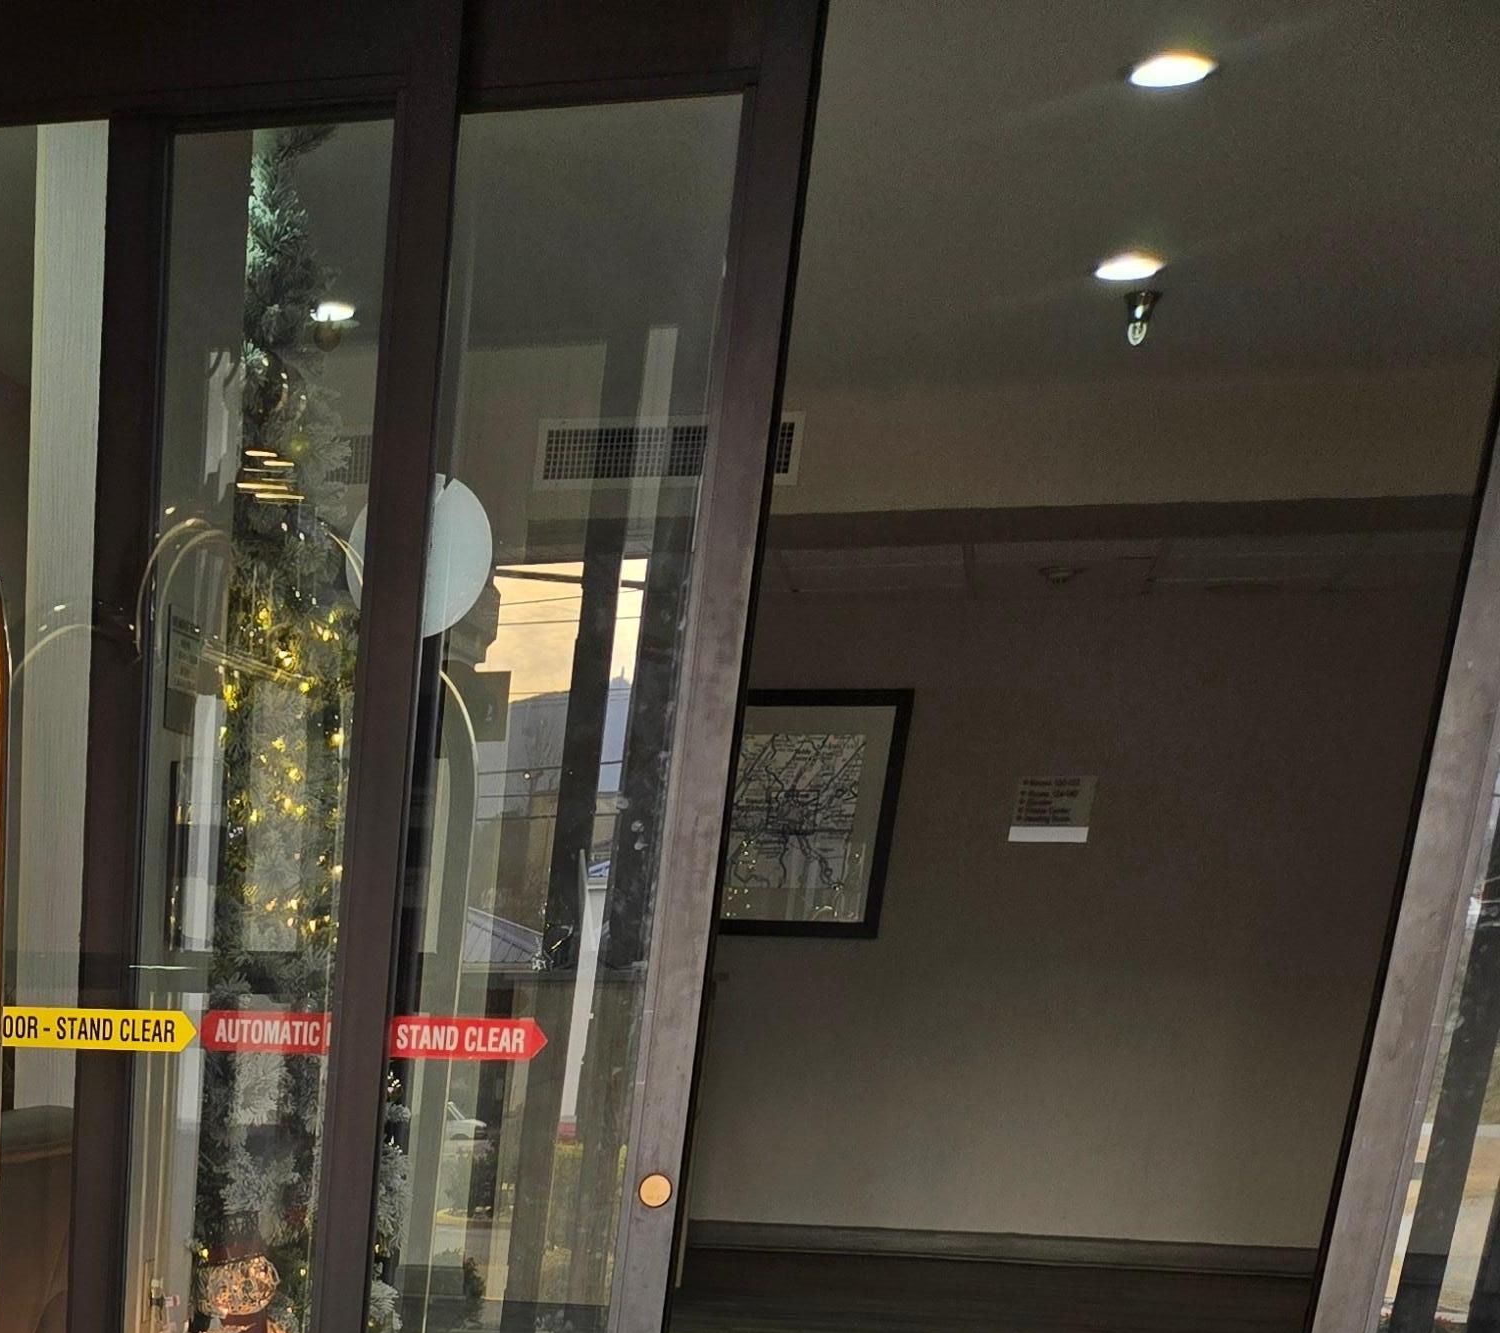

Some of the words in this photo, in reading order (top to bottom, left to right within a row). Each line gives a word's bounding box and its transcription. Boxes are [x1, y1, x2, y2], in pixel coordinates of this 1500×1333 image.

[3, 1015, 38, 1039] OOR
[57, 1016, 113, 1041] STAND
[120, 1018, 175, 1043] CLEAR
[215, 1018, 320, 1046] AUTOMATIC
[396, 1024, 459, 1051] STAND
[464, 1026, 525, 1053] CLEAR
